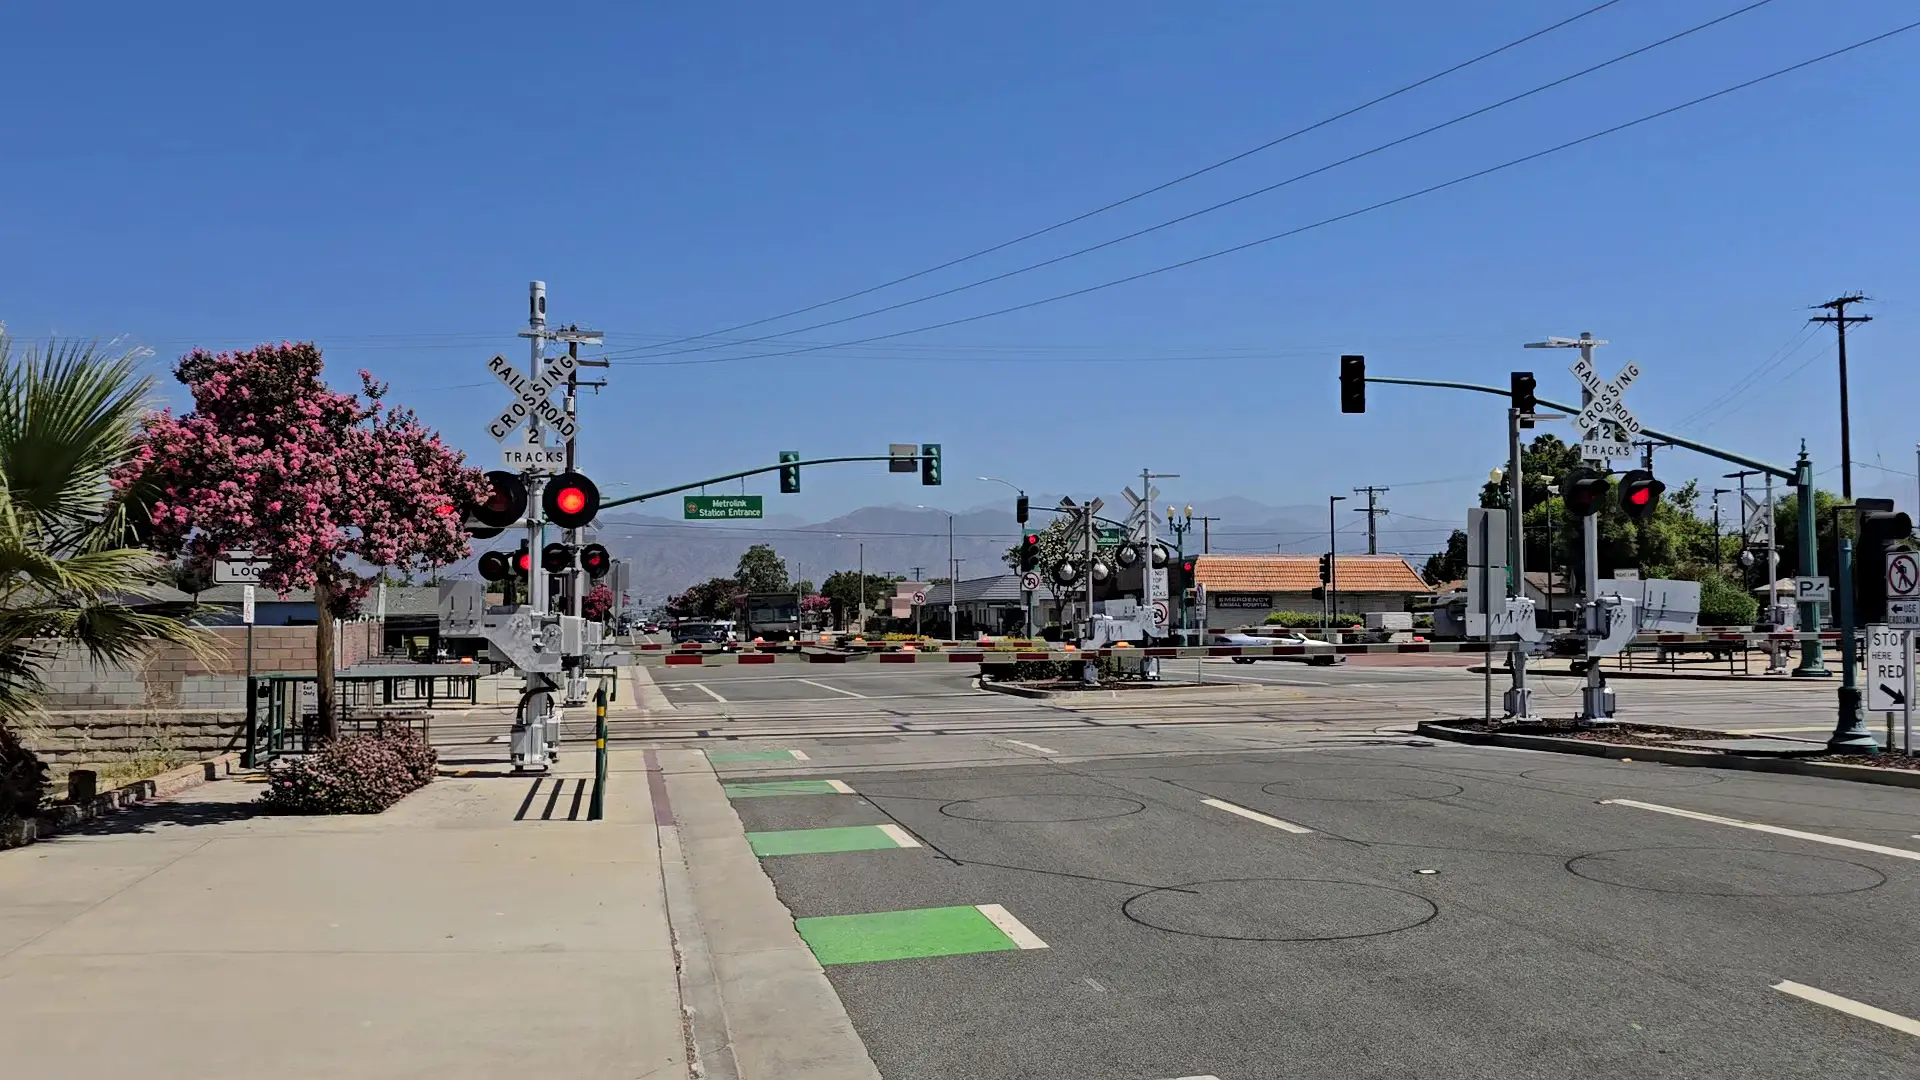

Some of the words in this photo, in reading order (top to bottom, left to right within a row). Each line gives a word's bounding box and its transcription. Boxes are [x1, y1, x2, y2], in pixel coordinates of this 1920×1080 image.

[489, 356, 525, 394] RAIL
[535, 399, 574, 437] ROAD
[491, 355, 573, 438] CROSSING
[1574, 361, 1600, 393] RAIL
[1611, 402, 1639, 433] ROAD
[1579, 365, 1639, 429] CROSSING
[528, 428, 539, 444] 2
[1602, 423, 1611, 439] 2
[1584, 444, 1630, 456] TRACKS
[505, 452, 563, 462] TRACKS
[712, 499, 747, 508] Metrolink
[699, 508, 726, 517] Station
[728, 508, 761, 517] Entrance
[231, 567, 261, 576] LOO
[1800, 581, 1814, 597] P
[1903, 603, 1917, 613] USE
[1888, 615, 1919, 625] CROSSWALK
[1871, 651, 1892, 660] HERE
[1878, 664, 1905, 678] RED
